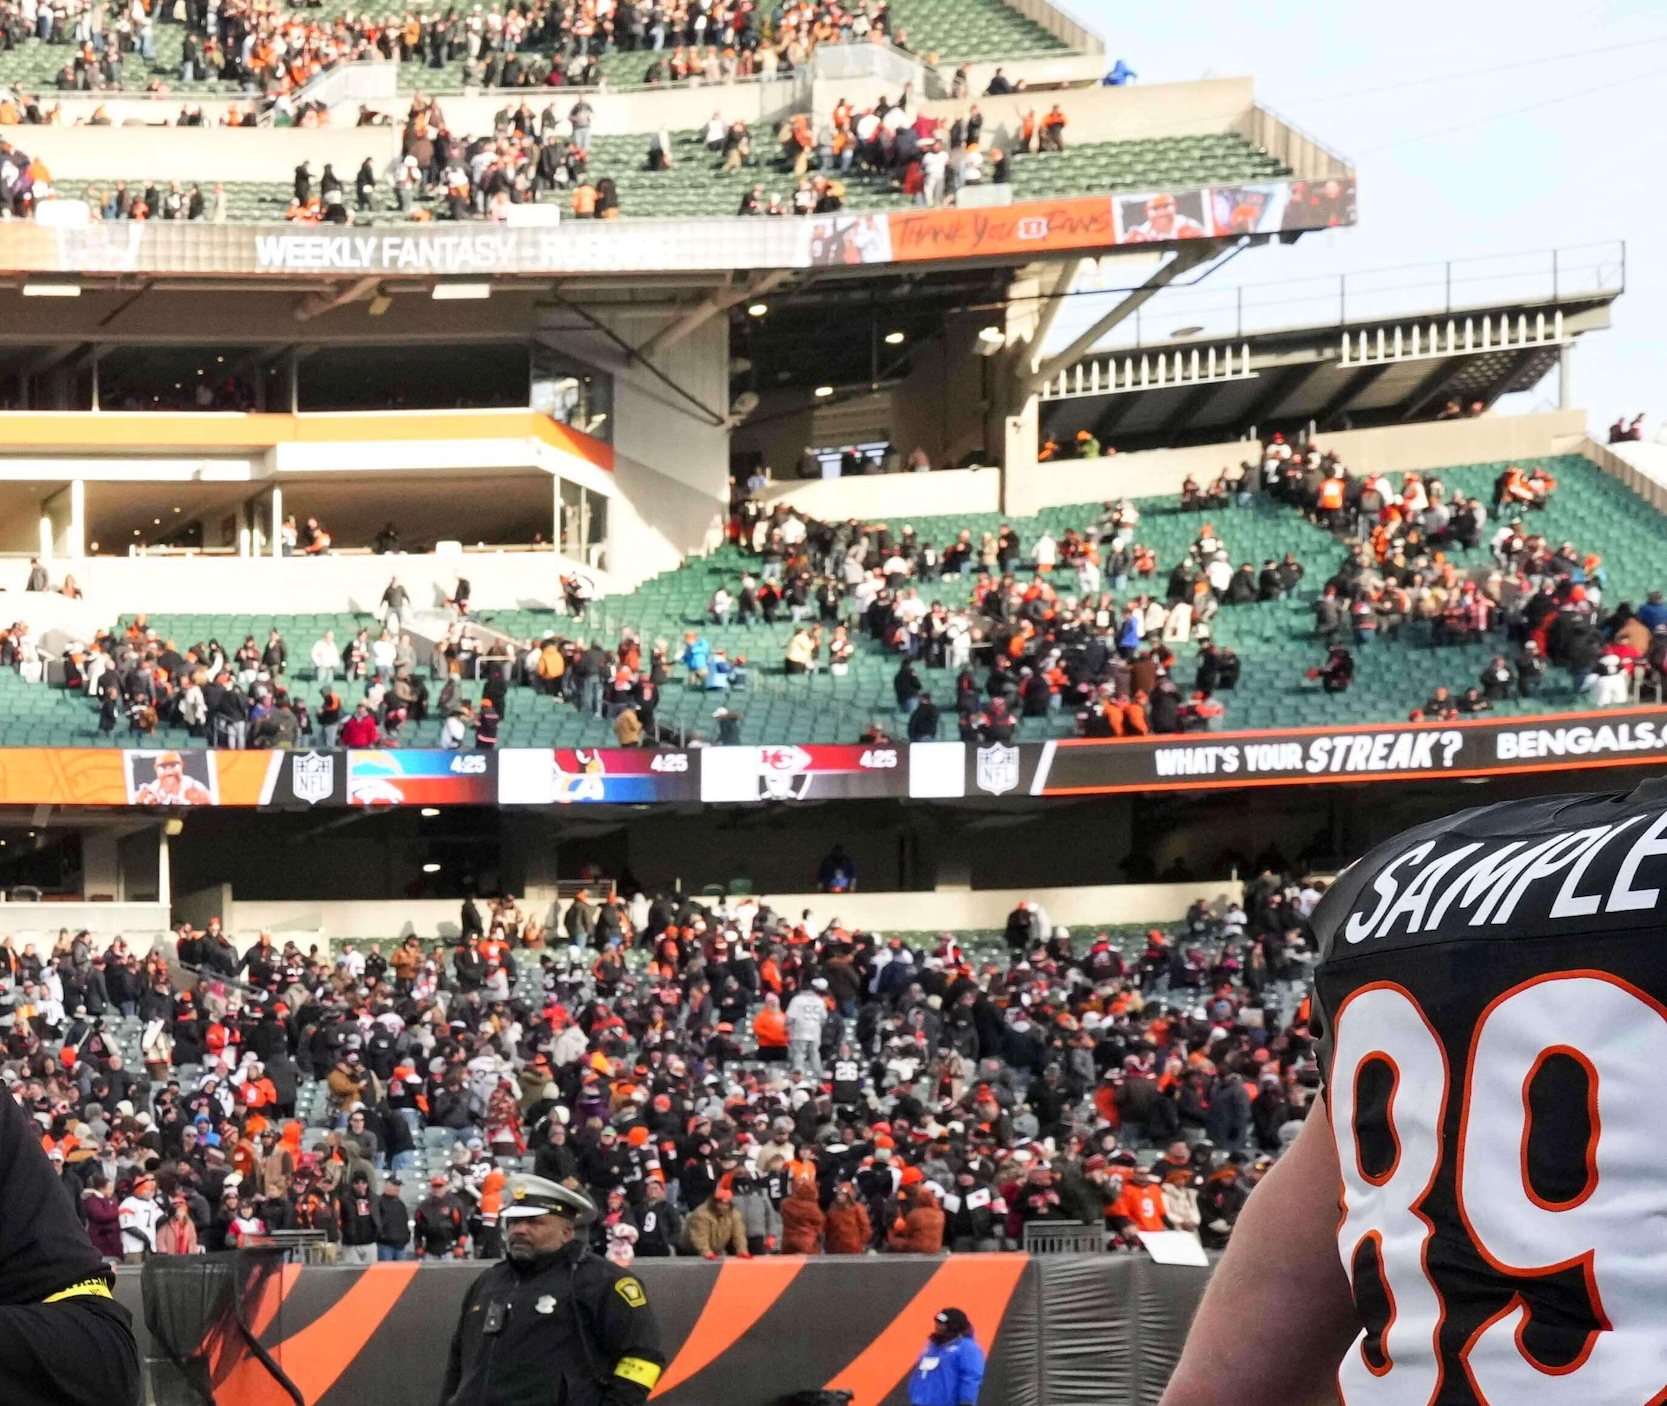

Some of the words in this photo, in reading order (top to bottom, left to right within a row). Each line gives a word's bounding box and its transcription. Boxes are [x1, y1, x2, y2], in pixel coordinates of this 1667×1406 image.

[255, 235, 376, 268] WEEKLY
[383, 235, 516, 268] FANTASY
[1496, 721, 1667, 760] BENGALS.
[451, 754, 486, 773] 4:25
[651, 753, 688, 773] 4:25
[859, 749, 897, 769] 4:25
[1155, 745, 1240, 777] WHAT'S
[1245, 741, 1302, 773] YOUR
[1306, 730, 1463, 775] STREAK?
[298, 773, 328, 795] NFL
[983, 764, 1013, 786] NFL
[1141, 1198, 1154, 1218] 9
[644, 1211, 657, 1232] 9
